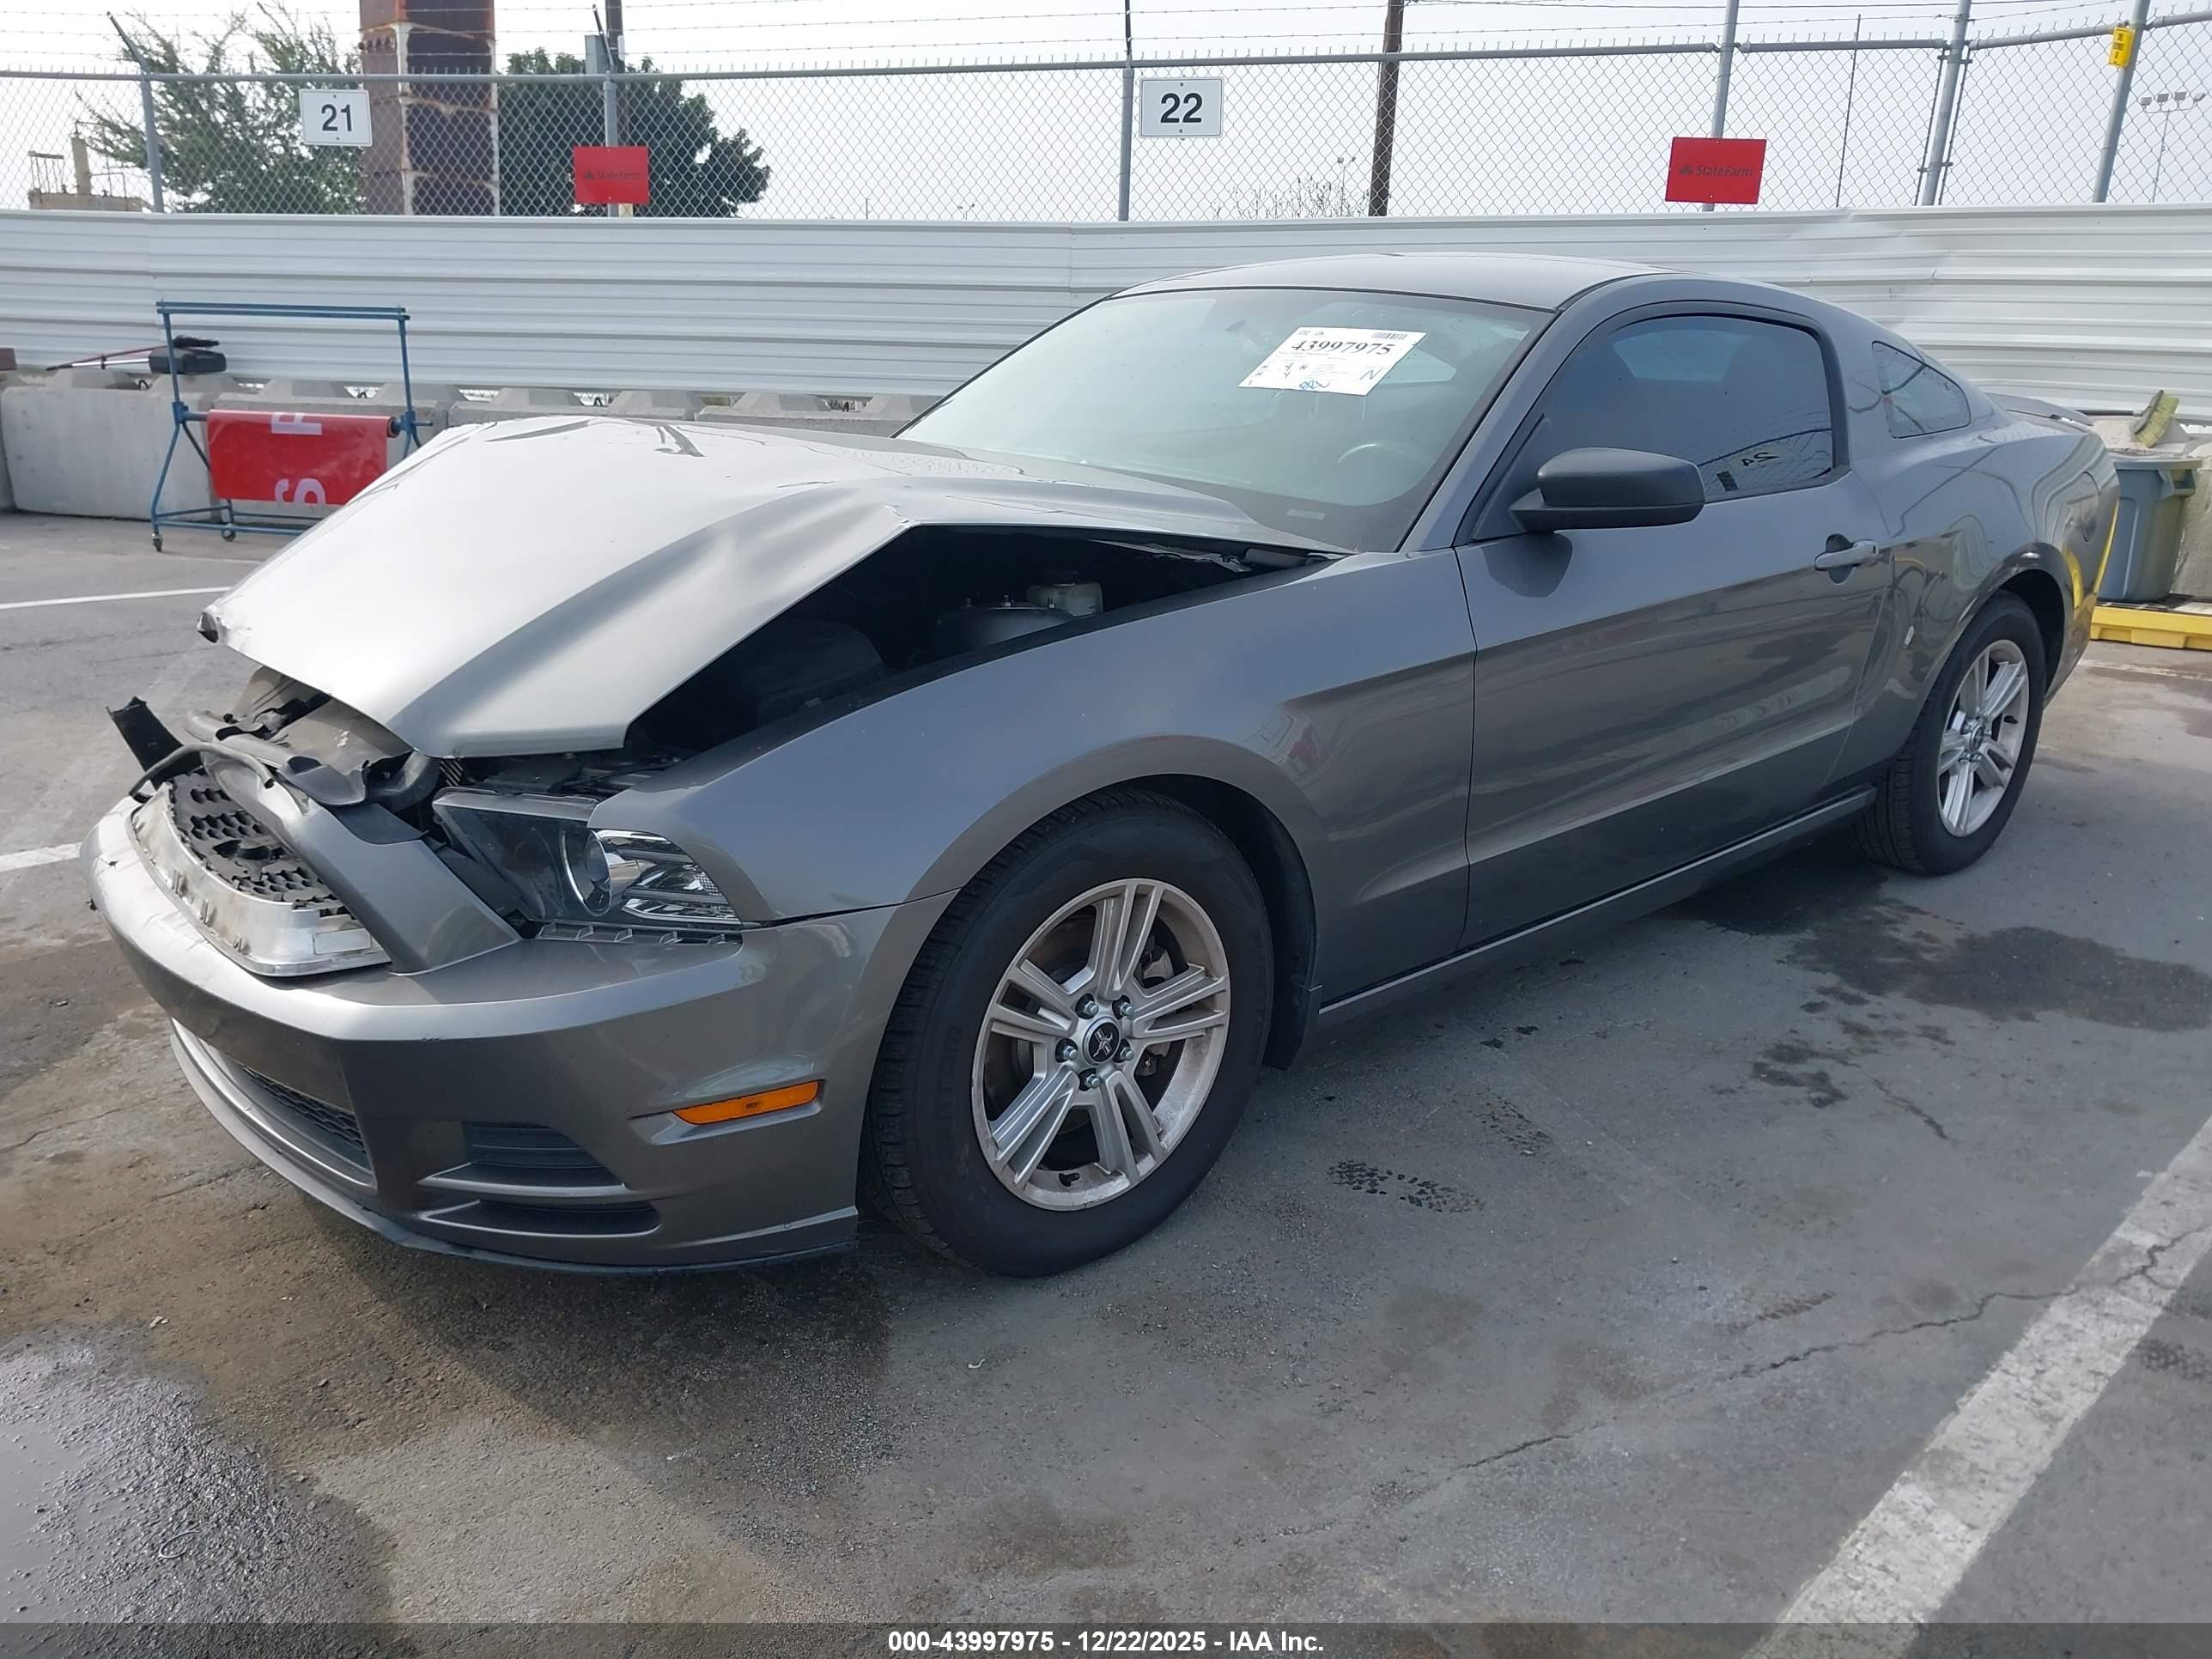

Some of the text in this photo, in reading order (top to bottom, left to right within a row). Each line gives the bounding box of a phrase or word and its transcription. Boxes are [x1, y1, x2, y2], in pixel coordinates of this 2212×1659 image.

[320, 103, 352, 132] 21
[1160, 92, 1203, 124] 22
[1291, 340, 1395, 356] 43997975
